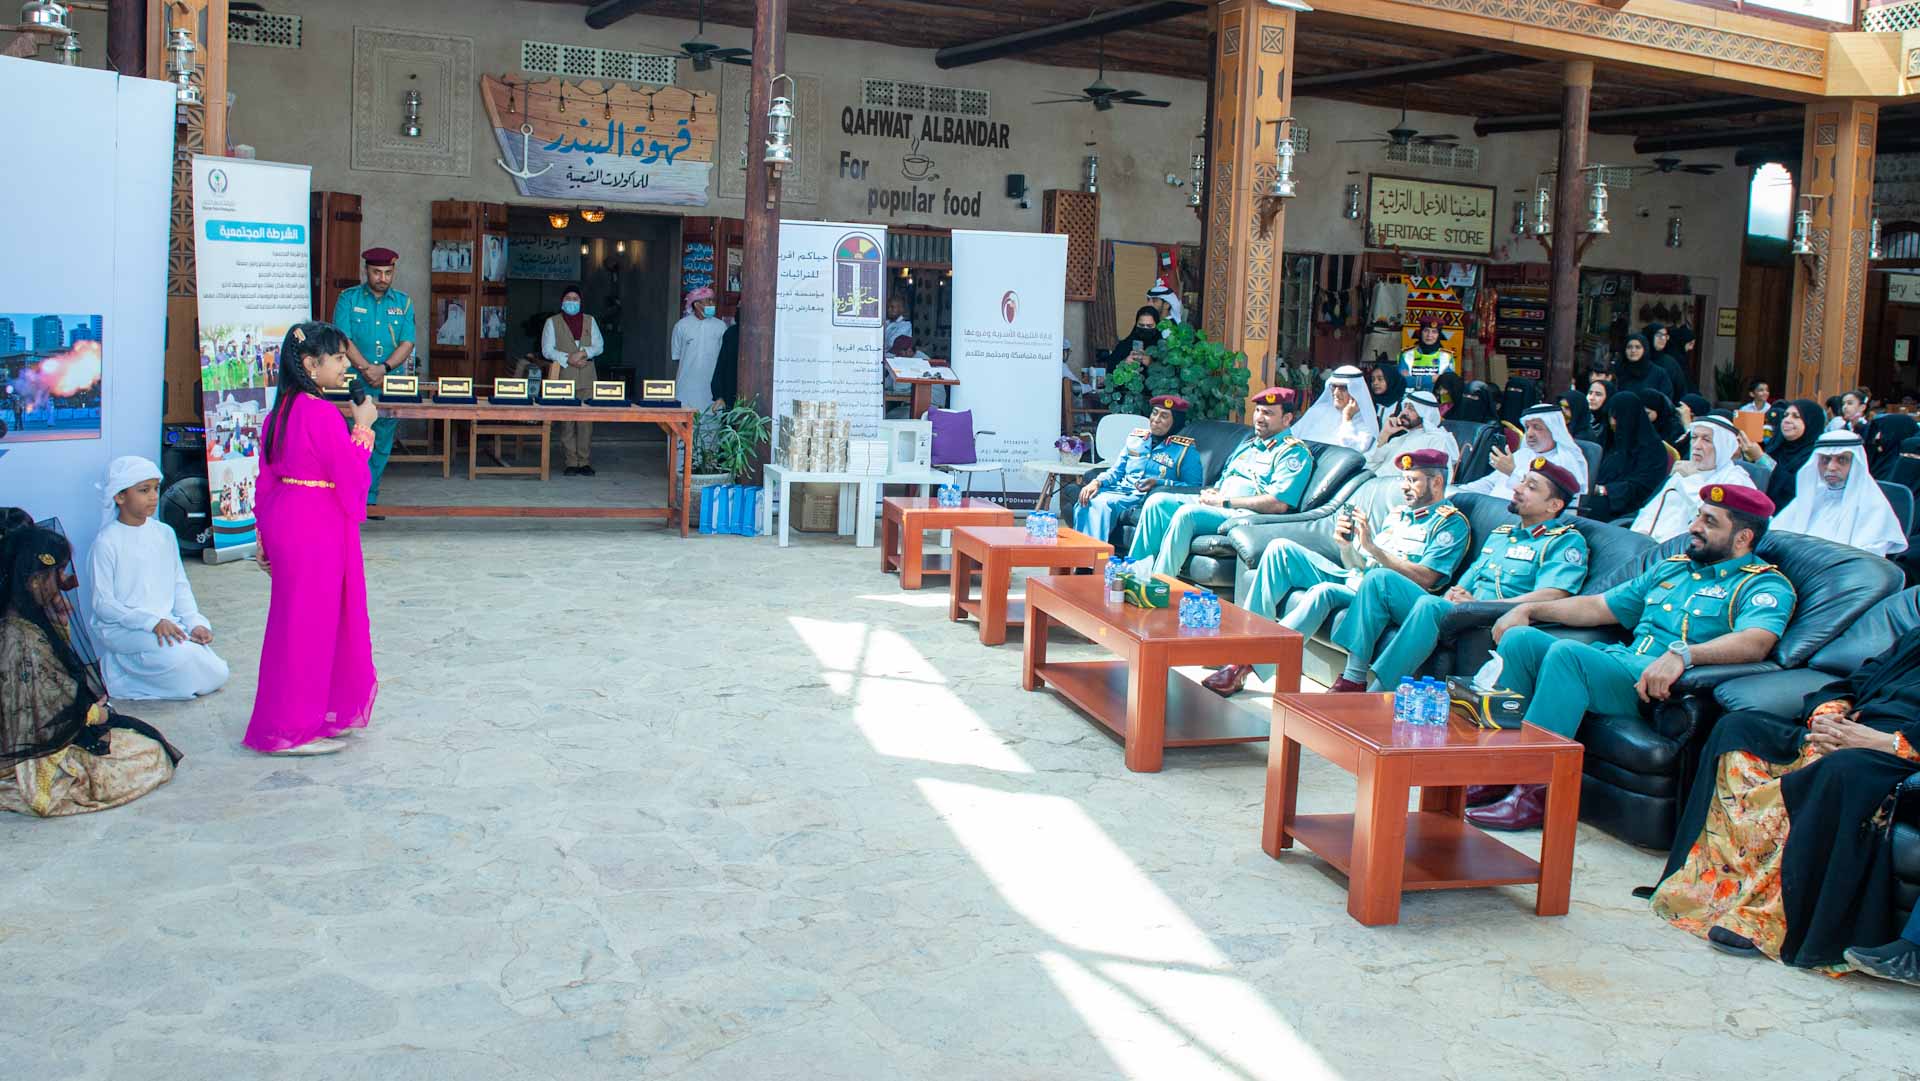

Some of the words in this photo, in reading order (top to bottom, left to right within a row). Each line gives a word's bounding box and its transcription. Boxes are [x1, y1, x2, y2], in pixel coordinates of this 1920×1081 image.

[842, 106, 913, 139] QAHWAT
[920, 115, 1010, 149] ALBANDAR
[544, 118, 624, 166] البندر
[631, 119, 692, 166] قهوة
[566, 165, 602, 189] الشعبية
[840, 151, 869, 181] For
[868, 185, 936, 217] popular
[944, 188, 982, 218] food
[1379, 188, 1412, 214] التراثية
[220, 224, 265, 240] المجتمعية
[266, 226, 298, 240] الشرطة
[1378, 223, 1437, 241] HERITAGE
[1444, 228, 1484, 245] STORE
[798, 251, 828, 262] حياكم
[781, 269, 819, 280] للتراثيات
[795, 290, 824, 298] مؤسسة
[857, 344, 881, 352] حياكم
[1038, 352, 1052, 360] أسرة
